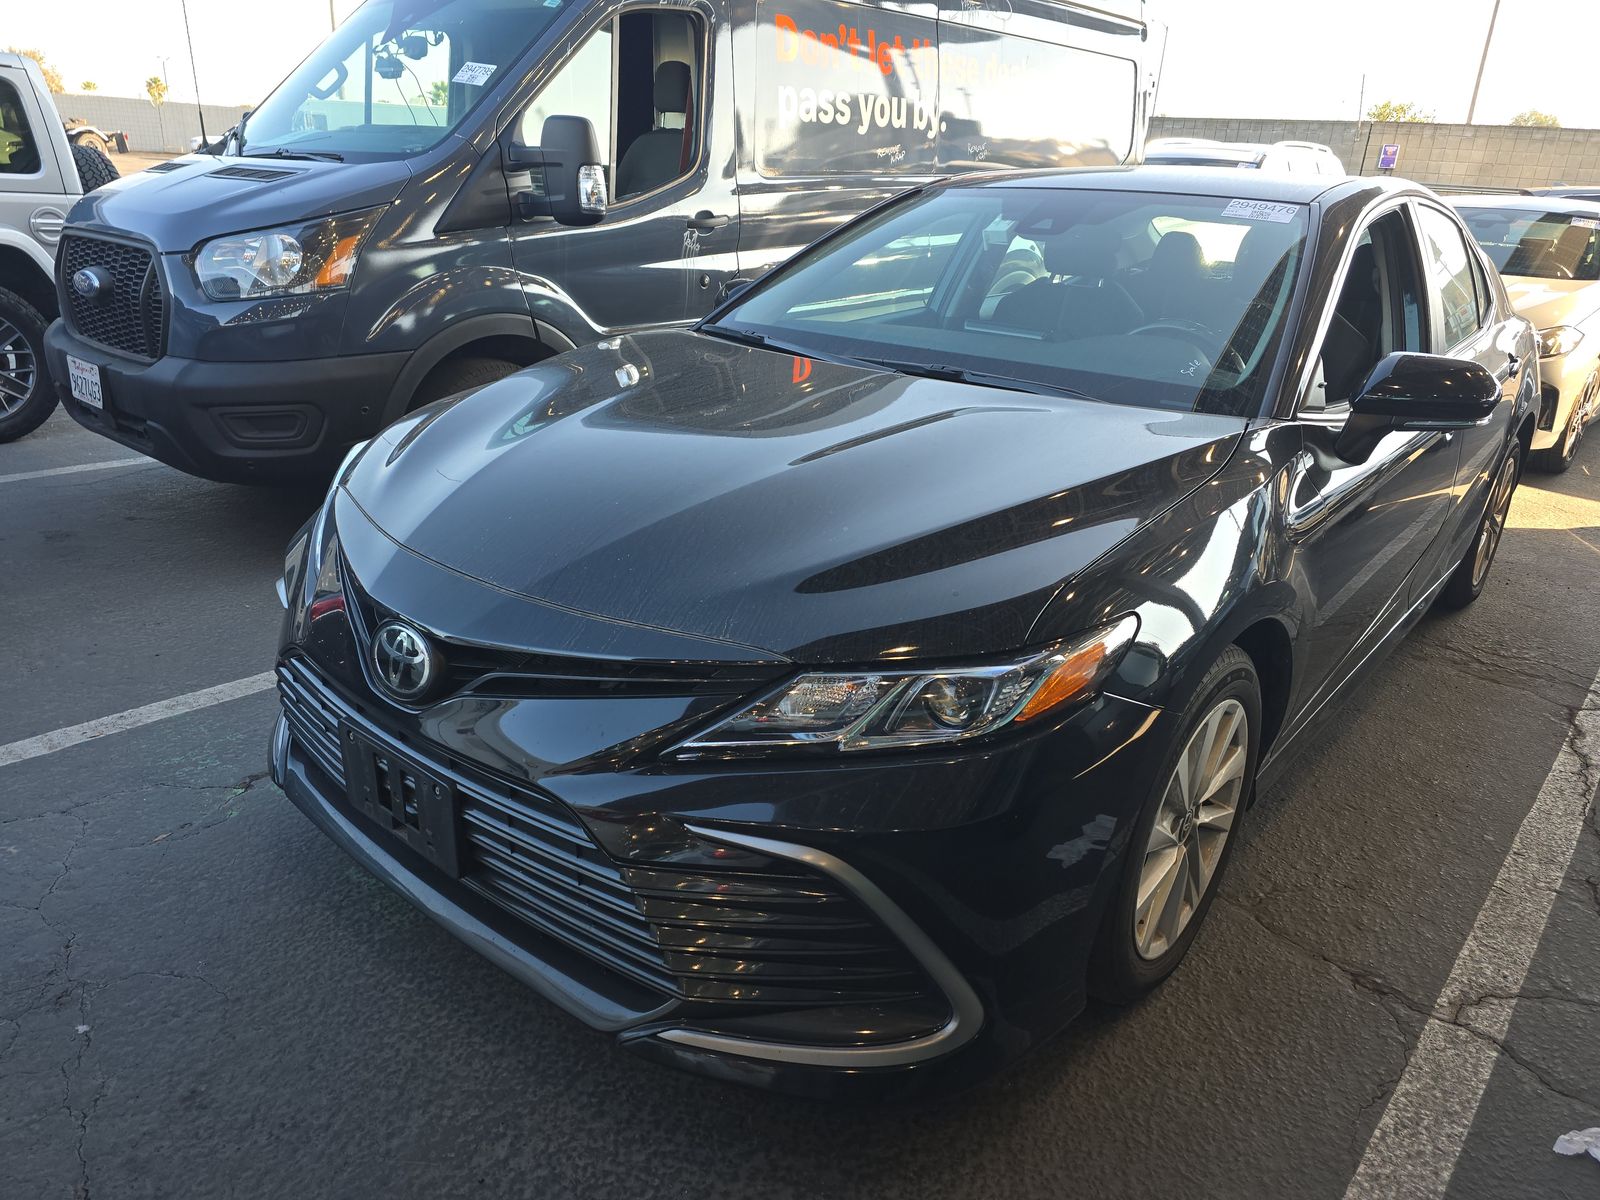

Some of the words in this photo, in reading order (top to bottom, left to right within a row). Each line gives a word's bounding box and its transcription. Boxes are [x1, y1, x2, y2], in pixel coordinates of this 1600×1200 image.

[775, 13, 862, 72] Don't
[868, 29, 906, 78] let
[777, 85, 851, 130] pass
[857, 93, 907, 135] you
[913, 89, 947, 139] by.
[1230, 200, 1297, 215] 2949476
